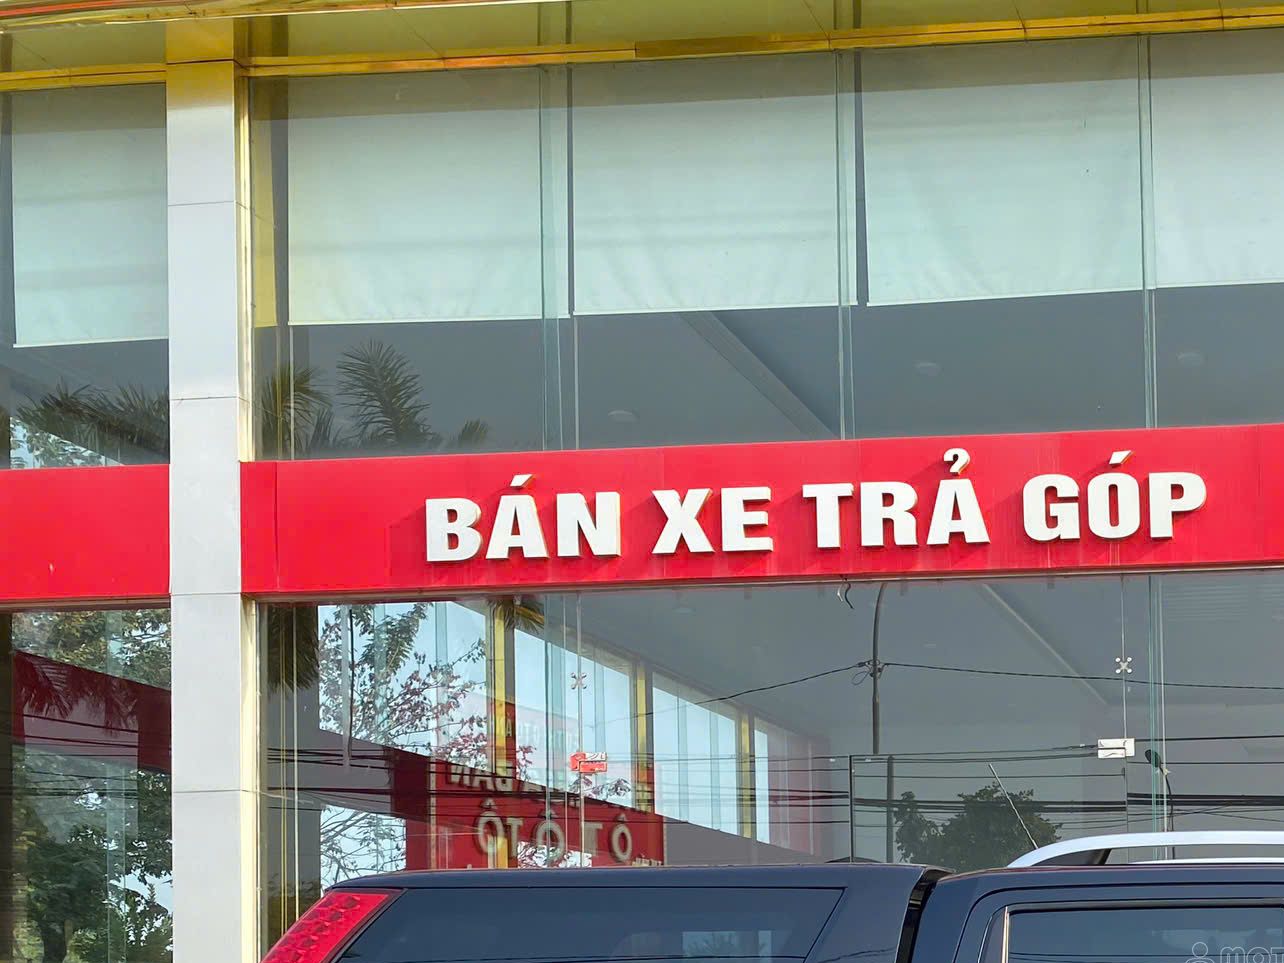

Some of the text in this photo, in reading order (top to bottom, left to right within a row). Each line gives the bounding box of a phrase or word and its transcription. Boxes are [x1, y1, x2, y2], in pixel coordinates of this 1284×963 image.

[425, 447, 1208, 562] BÁN XE TRẢ GÓP
